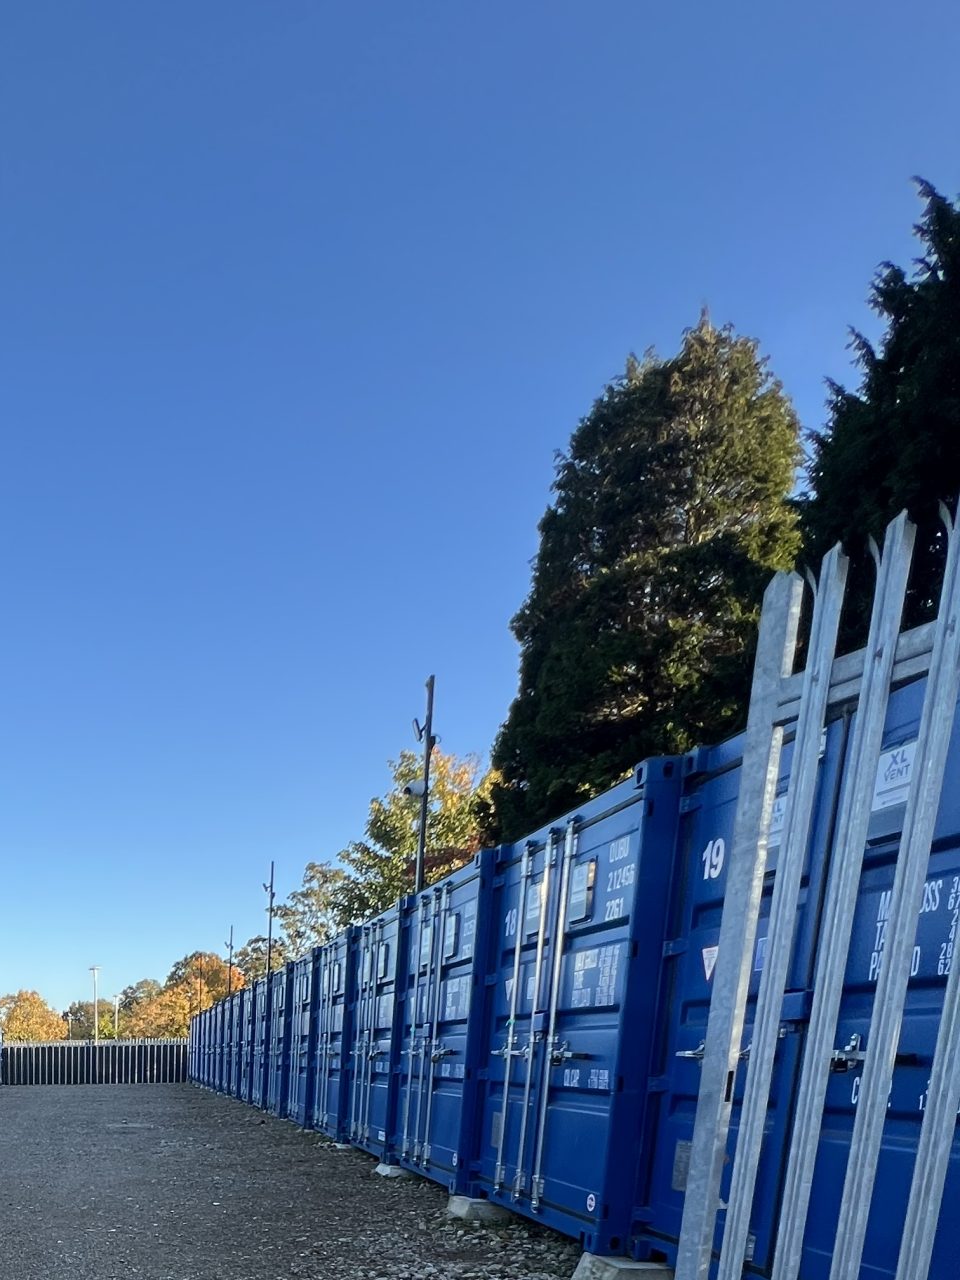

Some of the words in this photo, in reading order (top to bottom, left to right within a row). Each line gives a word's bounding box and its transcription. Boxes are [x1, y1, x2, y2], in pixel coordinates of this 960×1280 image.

[890, 750, 908, 765] XL
[884, 763, 911, 782] VENT
[702, 838, 726, 880] 19
[504, 908, 518, 937] 18
